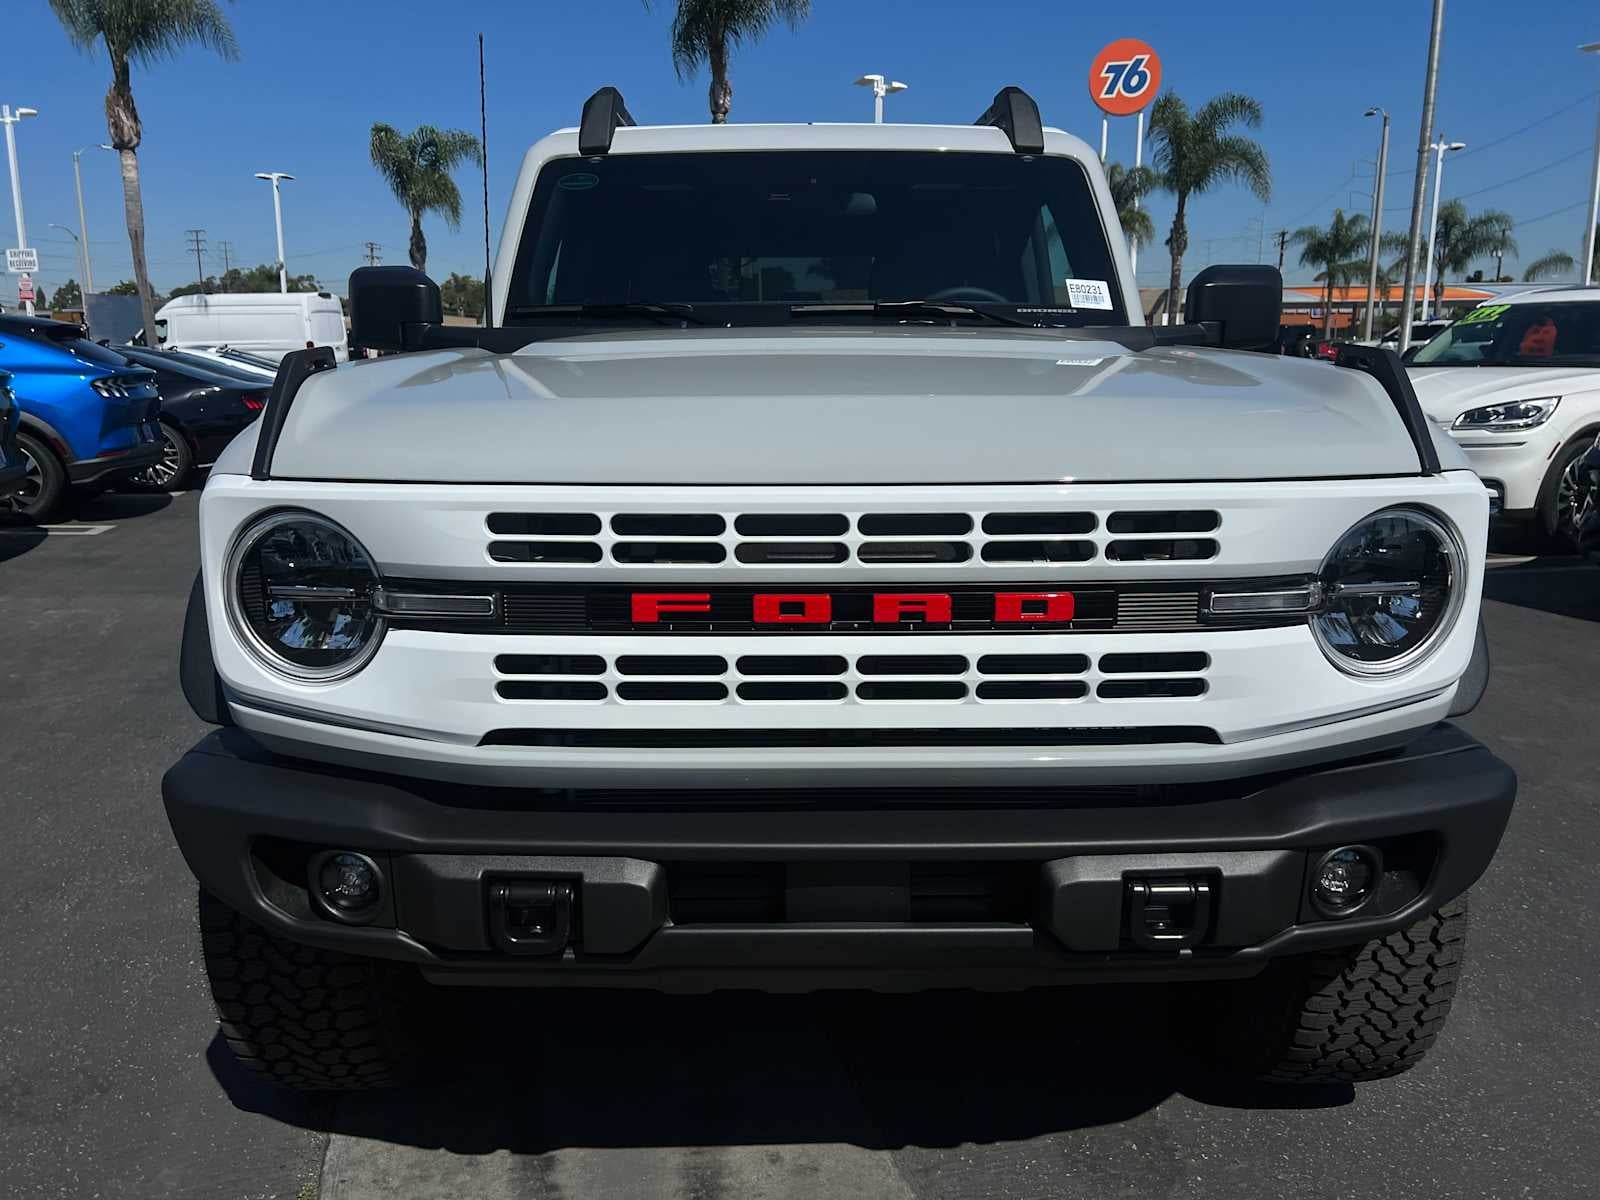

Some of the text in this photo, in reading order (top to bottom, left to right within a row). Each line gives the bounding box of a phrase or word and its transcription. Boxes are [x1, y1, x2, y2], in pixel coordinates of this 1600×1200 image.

[1100, 55, 1151, 98] 76
[1069, 283, 1103, 295] E80231
[631, 592, 1075, 623] FORD
